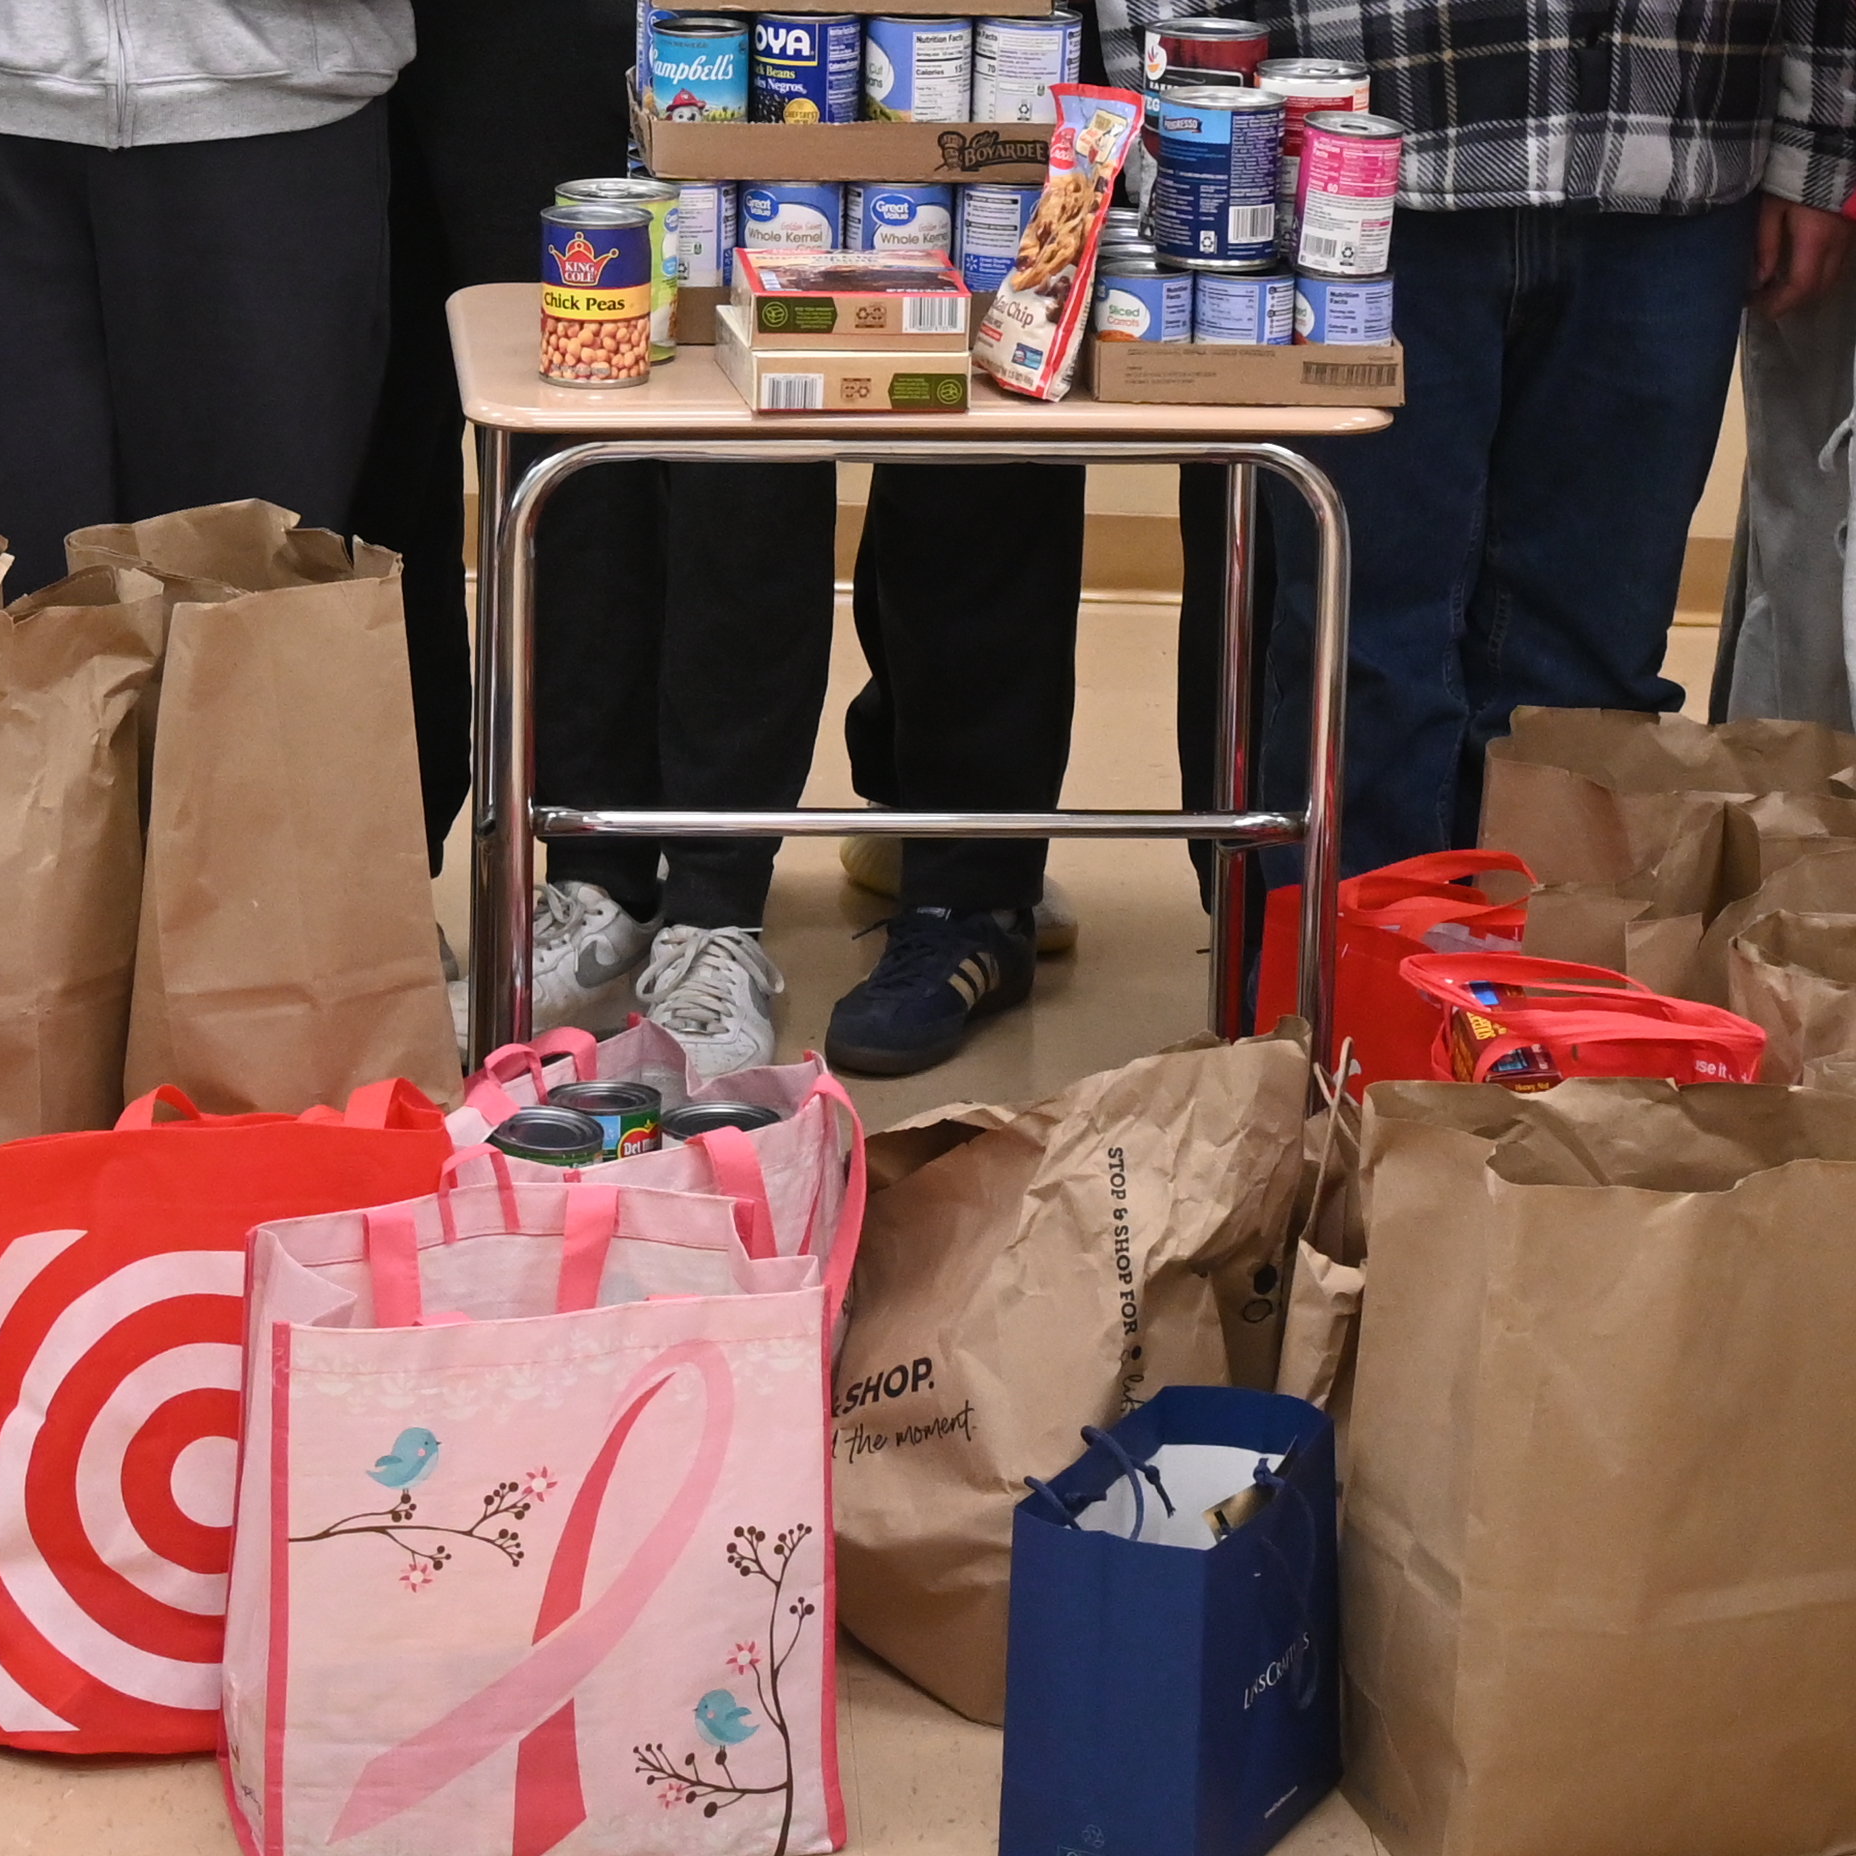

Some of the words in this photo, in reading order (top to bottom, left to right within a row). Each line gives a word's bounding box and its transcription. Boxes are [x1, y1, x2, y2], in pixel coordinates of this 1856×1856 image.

[915, 34, 947, 44] Nutrition
[766, 65, 796, 80] Beans
[915, 67, 945, 76] Calories
[972, 130, 1000, 147] Chef
[963, 142, 1045, 167] BOYARDEE
[745, 196, 772, 211] Great
[876, 200, 910, 213] Great
[749, 206, 772, 217] Value
[883, 209, 910, 221] Value
[747, 227, 782, 243] Whole
[785, 230, 824, 243] Kernel
[880, 232, 920, 244] Whole
[564, 261, 594, 272] KING
[564, 271, 595, 282] COLE
[544, 291, 580, 311] Chick
[585, 297, 626, 312] Peas
[1006, 300, 1035, 330] Chip
[1108, 304, 1140, 318] Sliced
[1106, 315, 1140, 328] Carrots
[623, 1140, 641, 1156] Del
[1108, 1147, 1127, 1201] STOP
[1113, 1207, 1128, 1222] &
[1114, 1224, 1133, 1286] SHOP
[1120, 1288, 1138, 1336] FOR
[842, 1357, 935, 1415] SHOP.
[844, 1422, 888, 1465] the
[895, 1399, 978, 1448] moment.
